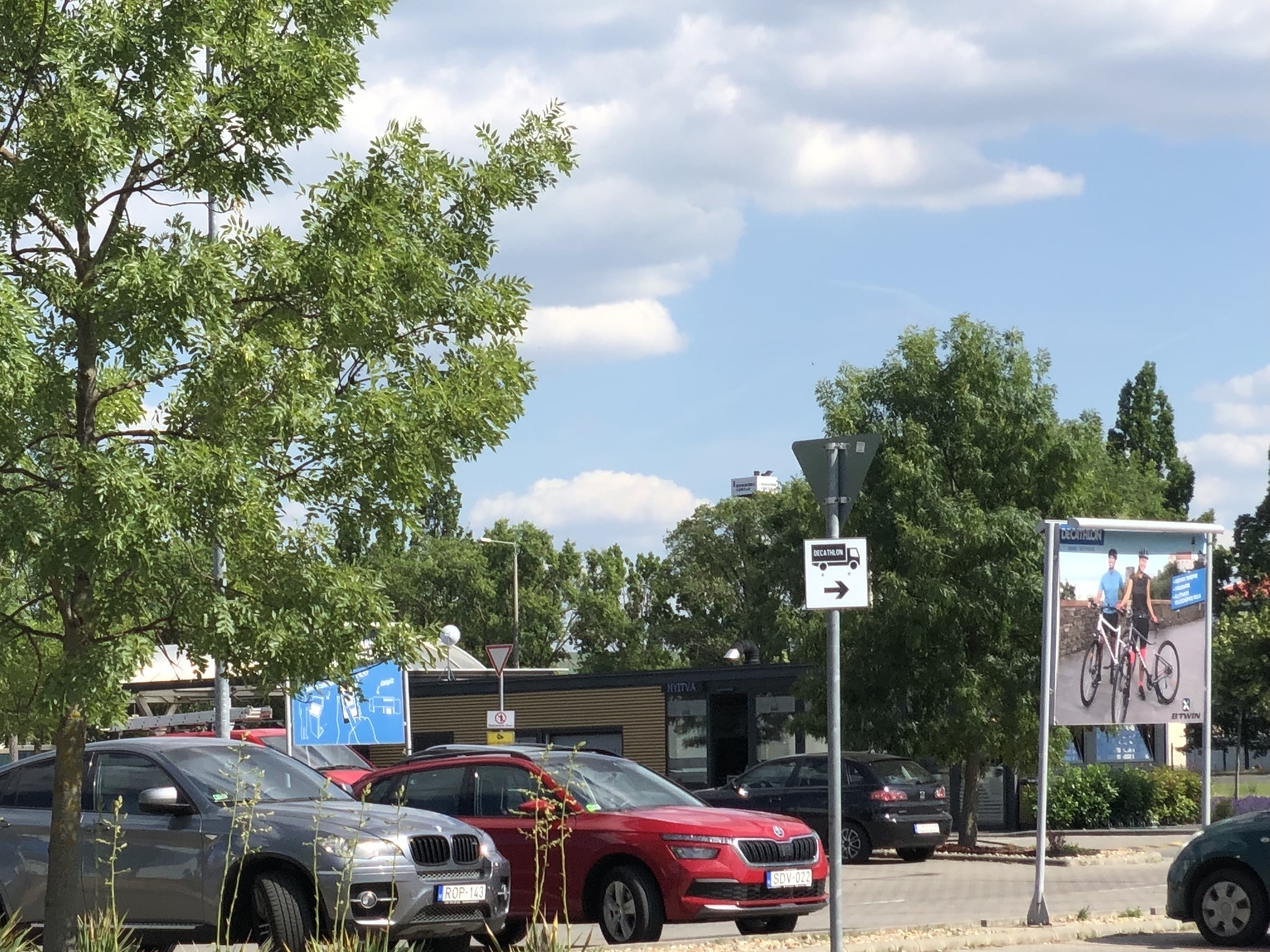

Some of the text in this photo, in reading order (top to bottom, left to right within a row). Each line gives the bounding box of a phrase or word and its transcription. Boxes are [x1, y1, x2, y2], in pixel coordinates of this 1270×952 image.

[1061, 528, 1102, 541] DECATHLON
[813, 548, 844, 557] DECATHLON
[773, 870, 811, 884] SDV-022
[444, 886, 484, 899] ROP-143
